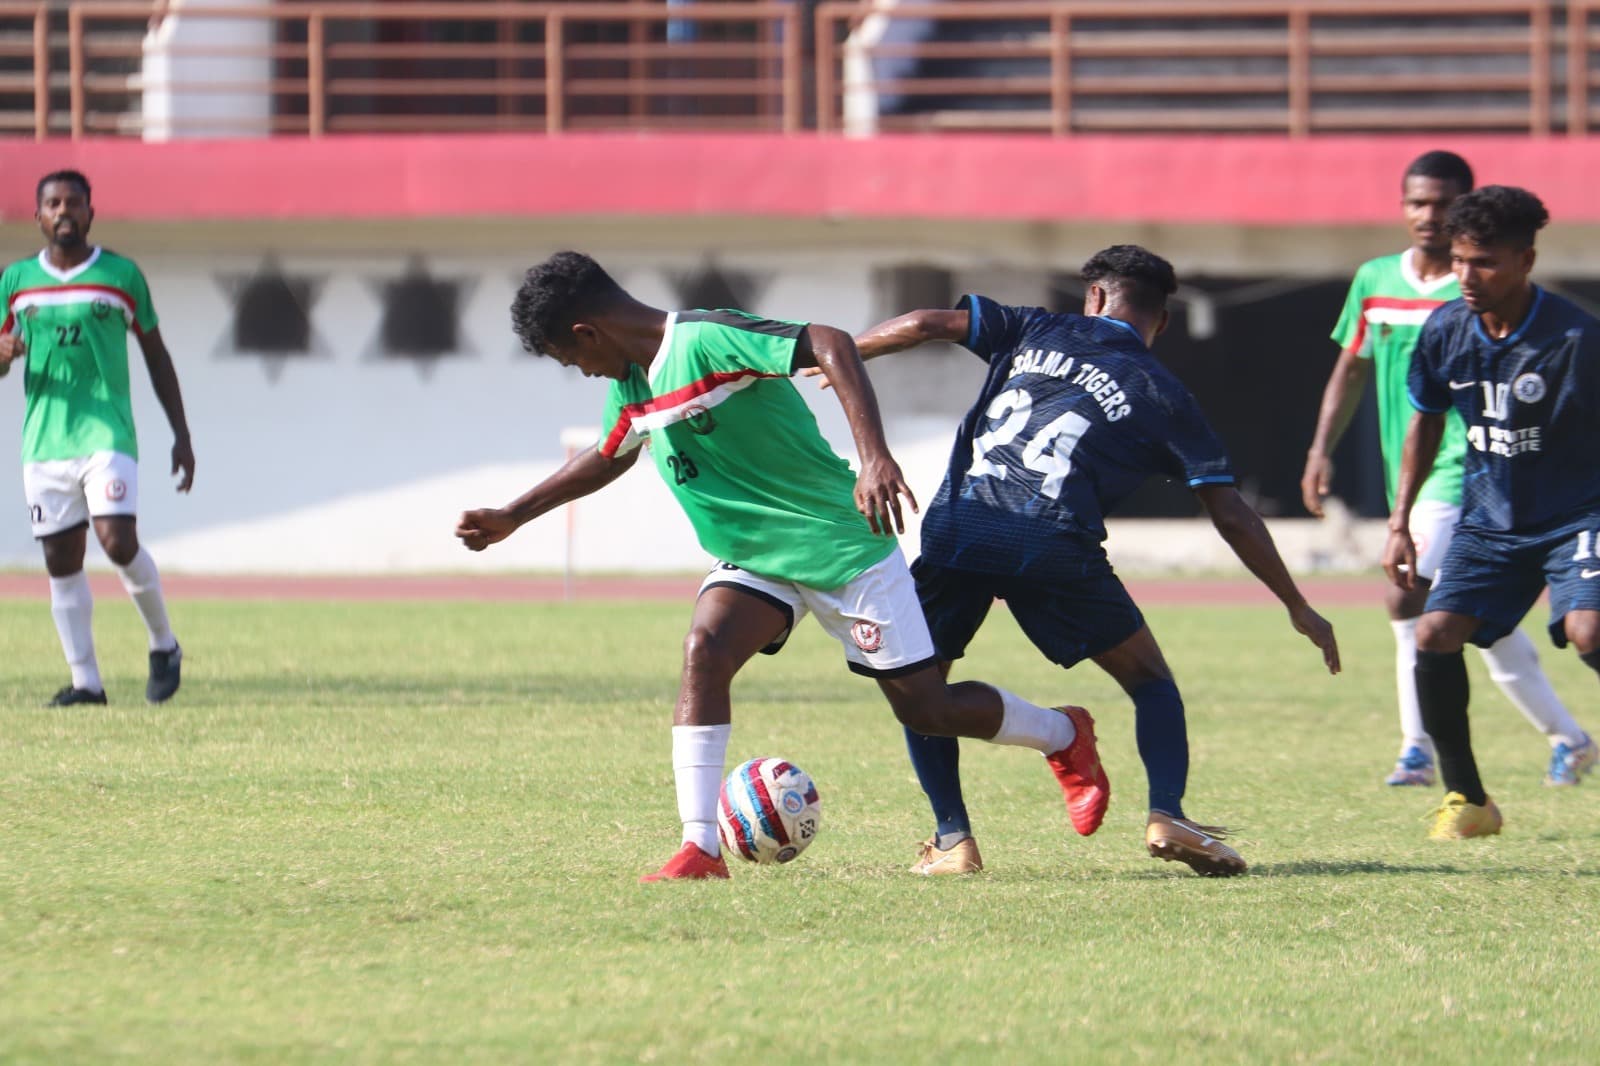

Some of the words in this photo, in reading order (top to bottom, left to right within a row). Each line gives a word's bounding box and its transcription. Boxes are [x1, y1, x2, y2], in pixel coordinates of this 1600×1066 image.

[56, 326, 82, 346] 22
[1072, 363, 1132, 422] TIGERS
[1480, 381, 1509, 421] 10
[967, 388, 1092, 499] 24
[667, 451, 698, 485] 25
